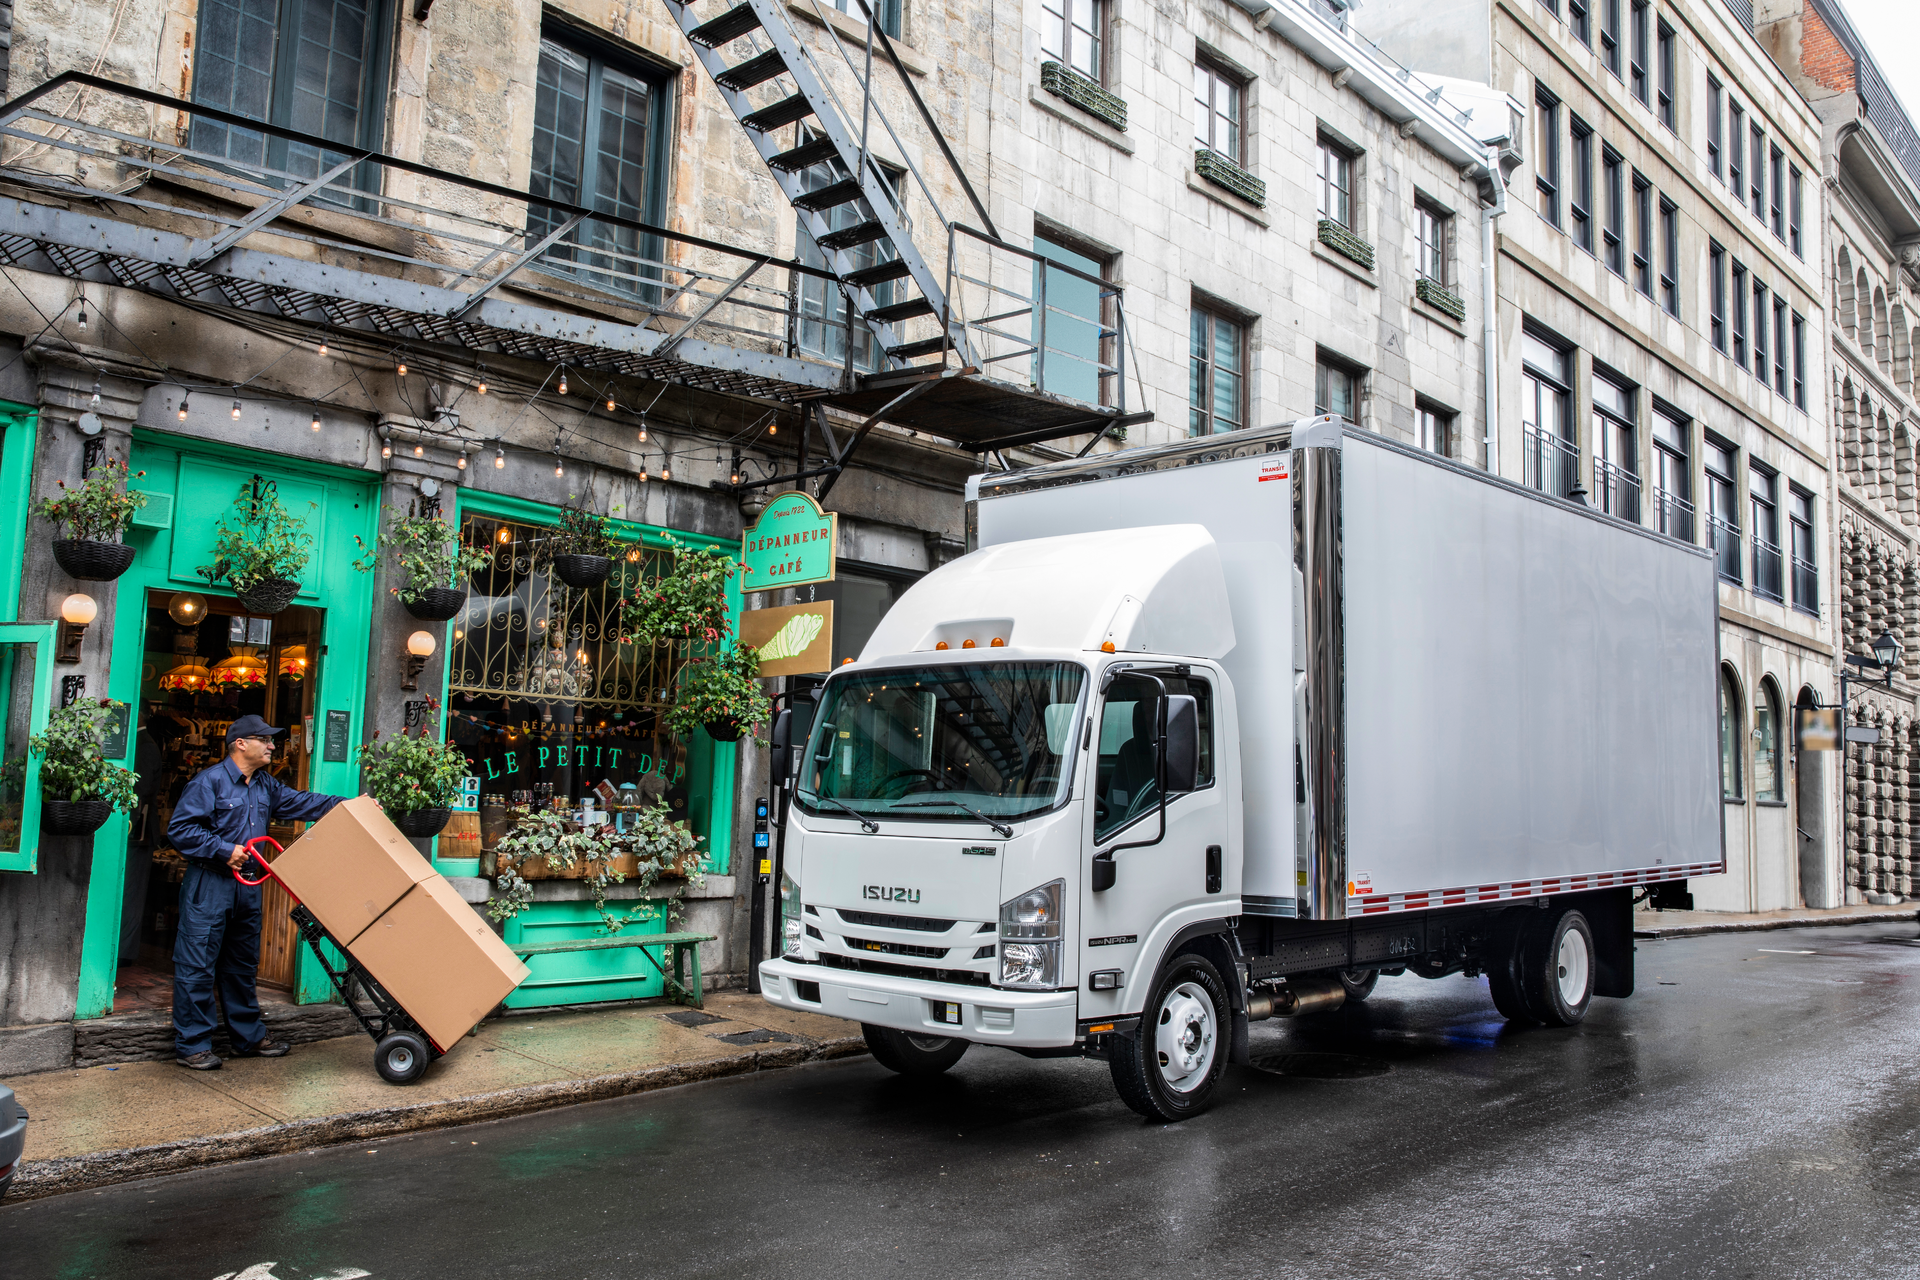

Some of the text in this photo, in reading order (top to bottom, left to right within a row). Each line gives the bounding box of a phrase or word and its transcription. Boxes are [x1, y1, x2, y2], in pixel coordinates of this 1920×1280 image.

[1261, 465, 1285, 473] TRANSIT
[773, 507, 790, 521] Depuis
[749, 528, 829, 552] DÉPANNEUR
[769, 556, 803, 576] CAFÉ
[522, 719, 601, 734] DÉPANNEUR
[483, 745, 684, 785] LE PETIT DEP
[456, 832, 477, 841] ATM
[863, 884, 921, 904] ISUZU
[1103, 936, 1127, 945] NPR
